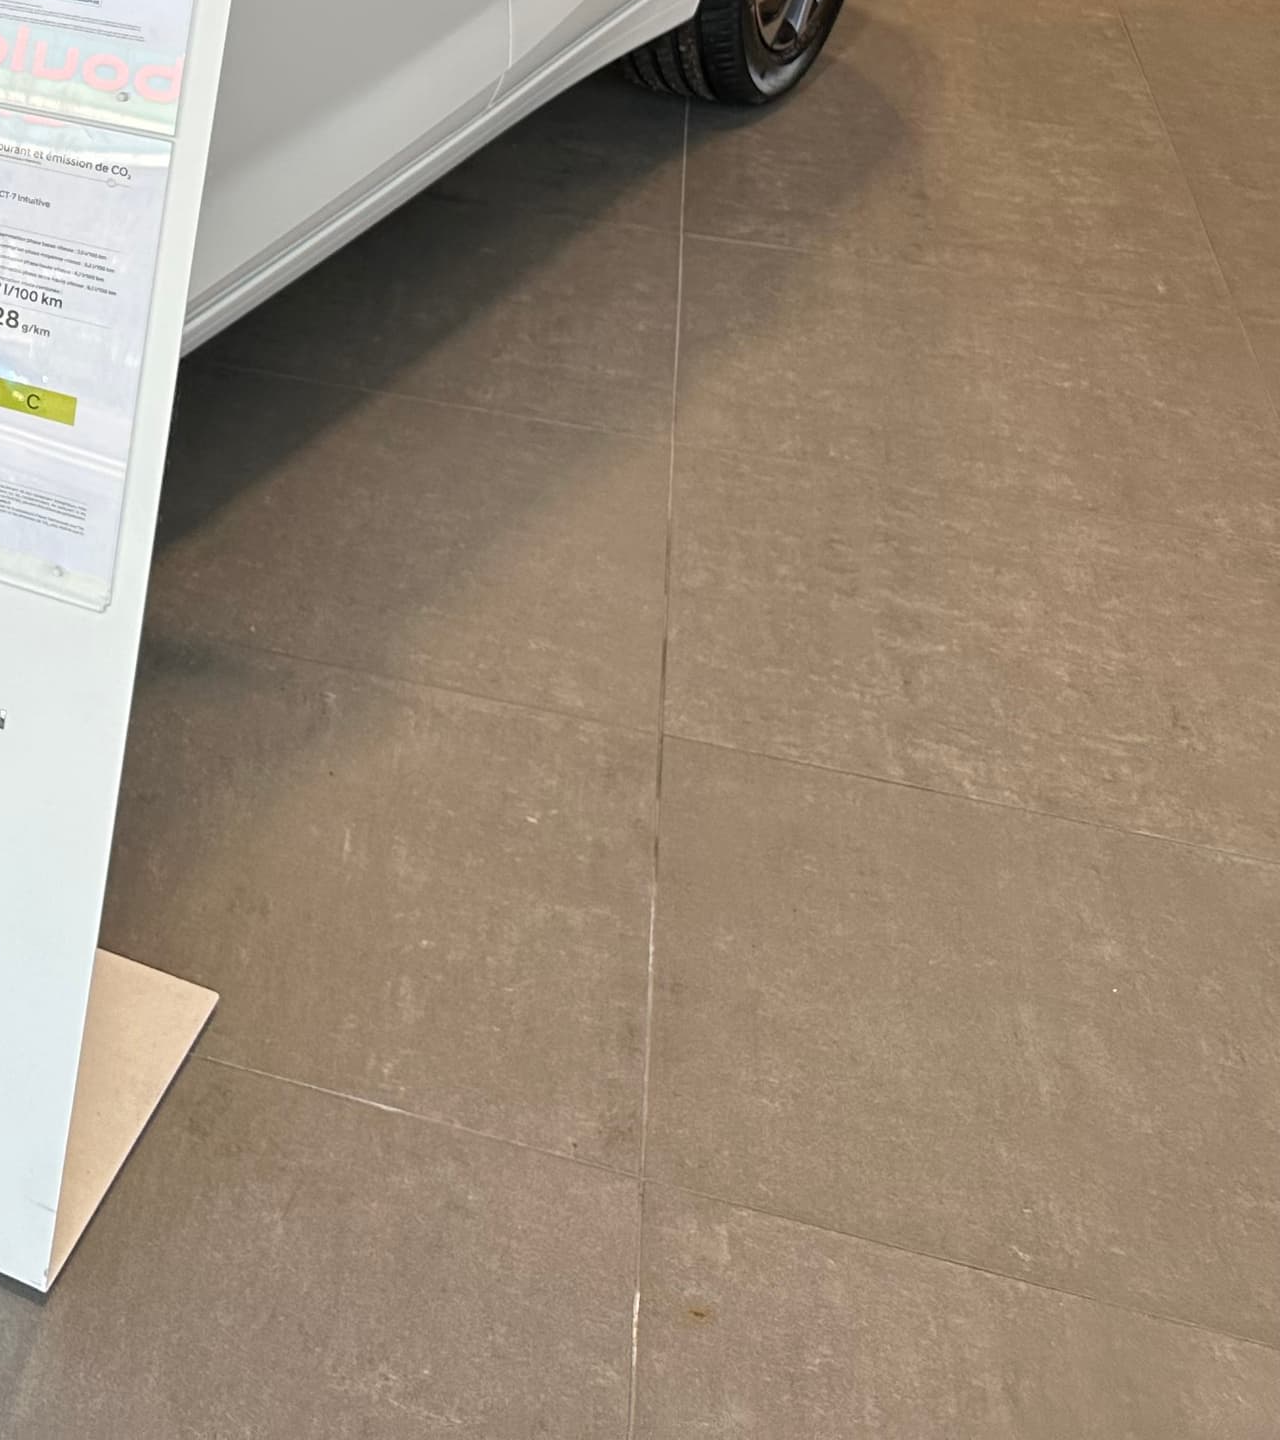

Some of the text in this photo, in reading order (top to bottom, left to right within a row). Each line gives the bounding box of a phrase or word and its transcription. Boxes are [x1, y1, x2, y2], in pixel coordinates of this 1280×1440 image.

[33, 150, 43, 160] et
[45, 150, 99, 170] émission
[95, 162, 109, 173] de
[3, 283, 38, 302] l/100
[41, 291, 63, 308] km
[21, 322, 51, 337] g/km
[26, 393, 40, 409] C
